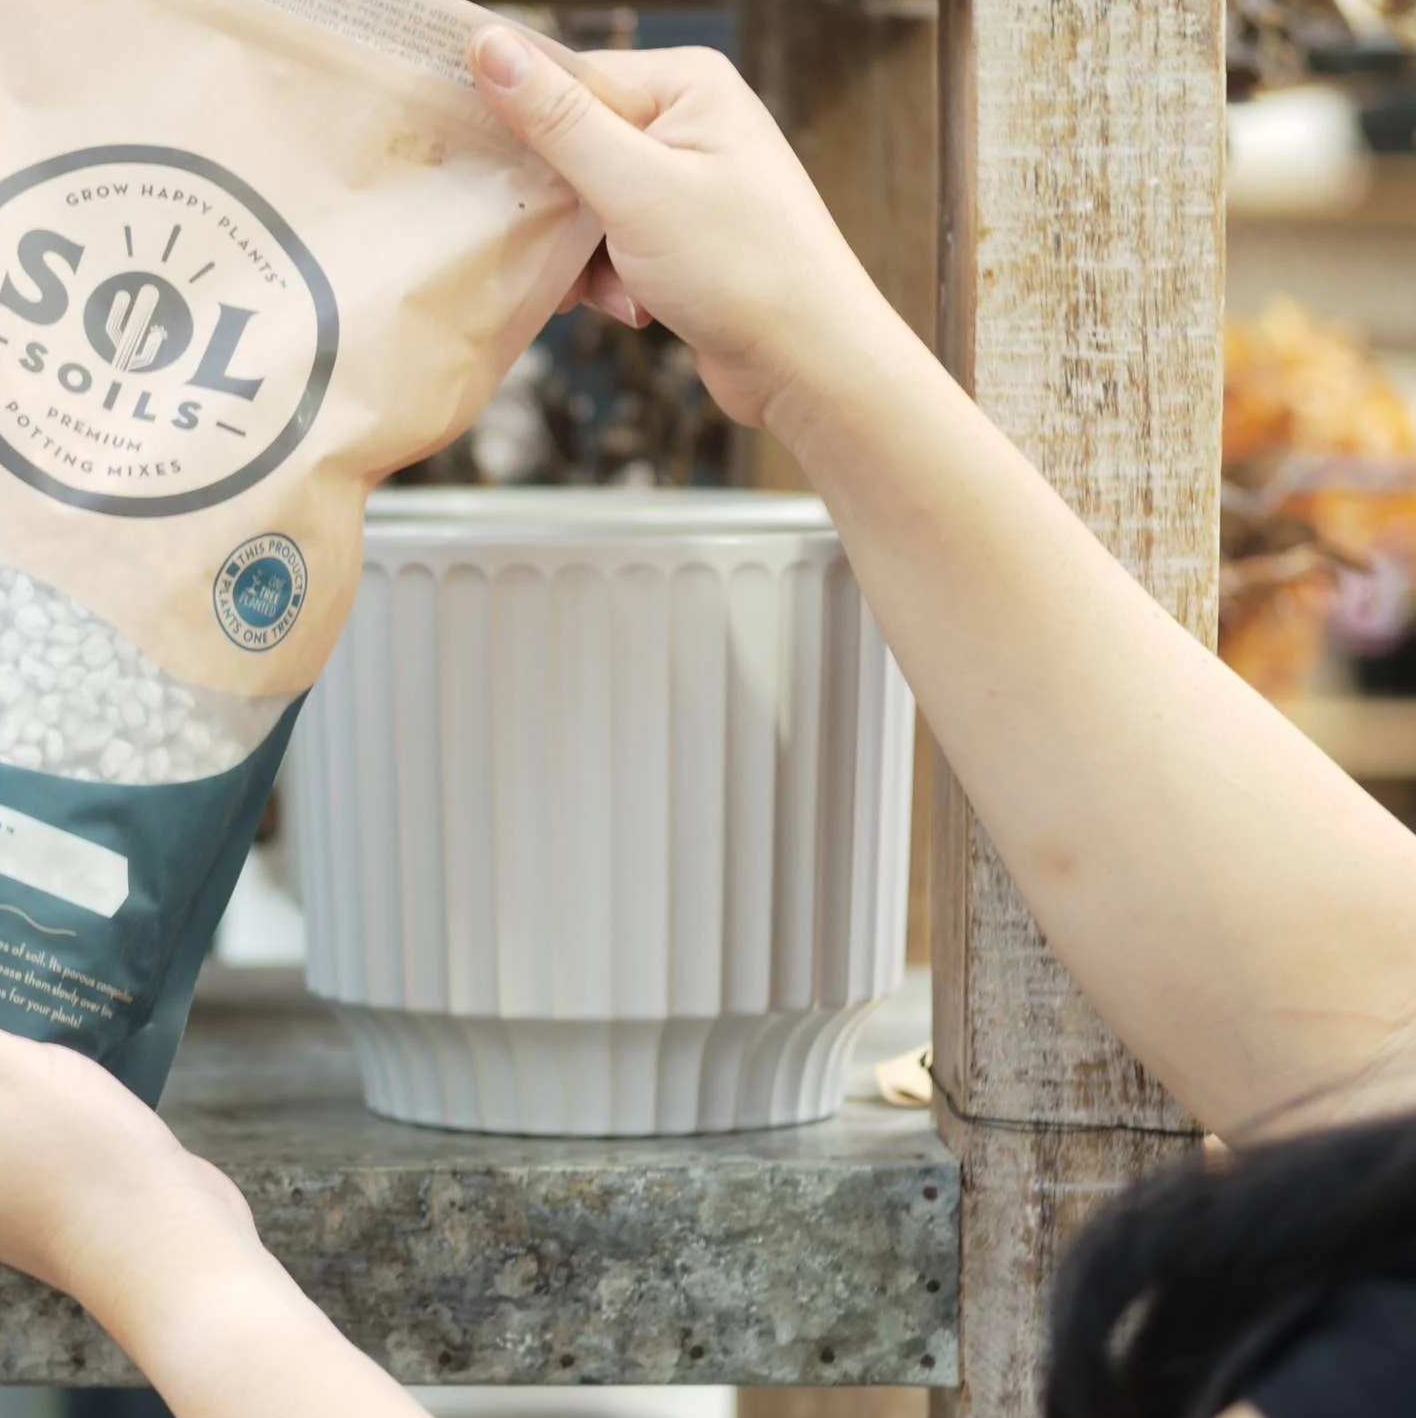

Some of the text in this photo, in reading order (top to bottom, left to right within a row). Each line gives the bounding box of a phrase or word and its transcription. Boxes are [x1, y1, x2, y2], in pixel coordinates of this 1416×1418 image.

[65, 184, 128, 206] GROW
[141, 185, 212, 215] HAPPY
[19, 342, 202, 431] SOILS
[6, 401, 182, 477] POTTING MIXES
[47, 406, 142, 453] PREMIUM
[238, 540, 303, 590] THIS PRODUCT
[219, 580, 294, 643] PLANTS ONE TREE
[12, 943, 25, 957] of
[26, 949, 46, 967] soil.
[49, 956, 62, 974] Its
[9, 988, 25, 1005] for
[28, 1000, 51, 1018] your
[51, 1006, 82, 1029] plants!
[25, 970, 51, 993] them
[52, 982, 79, 1006] slowly
[80, 998, 100, 1013] over
